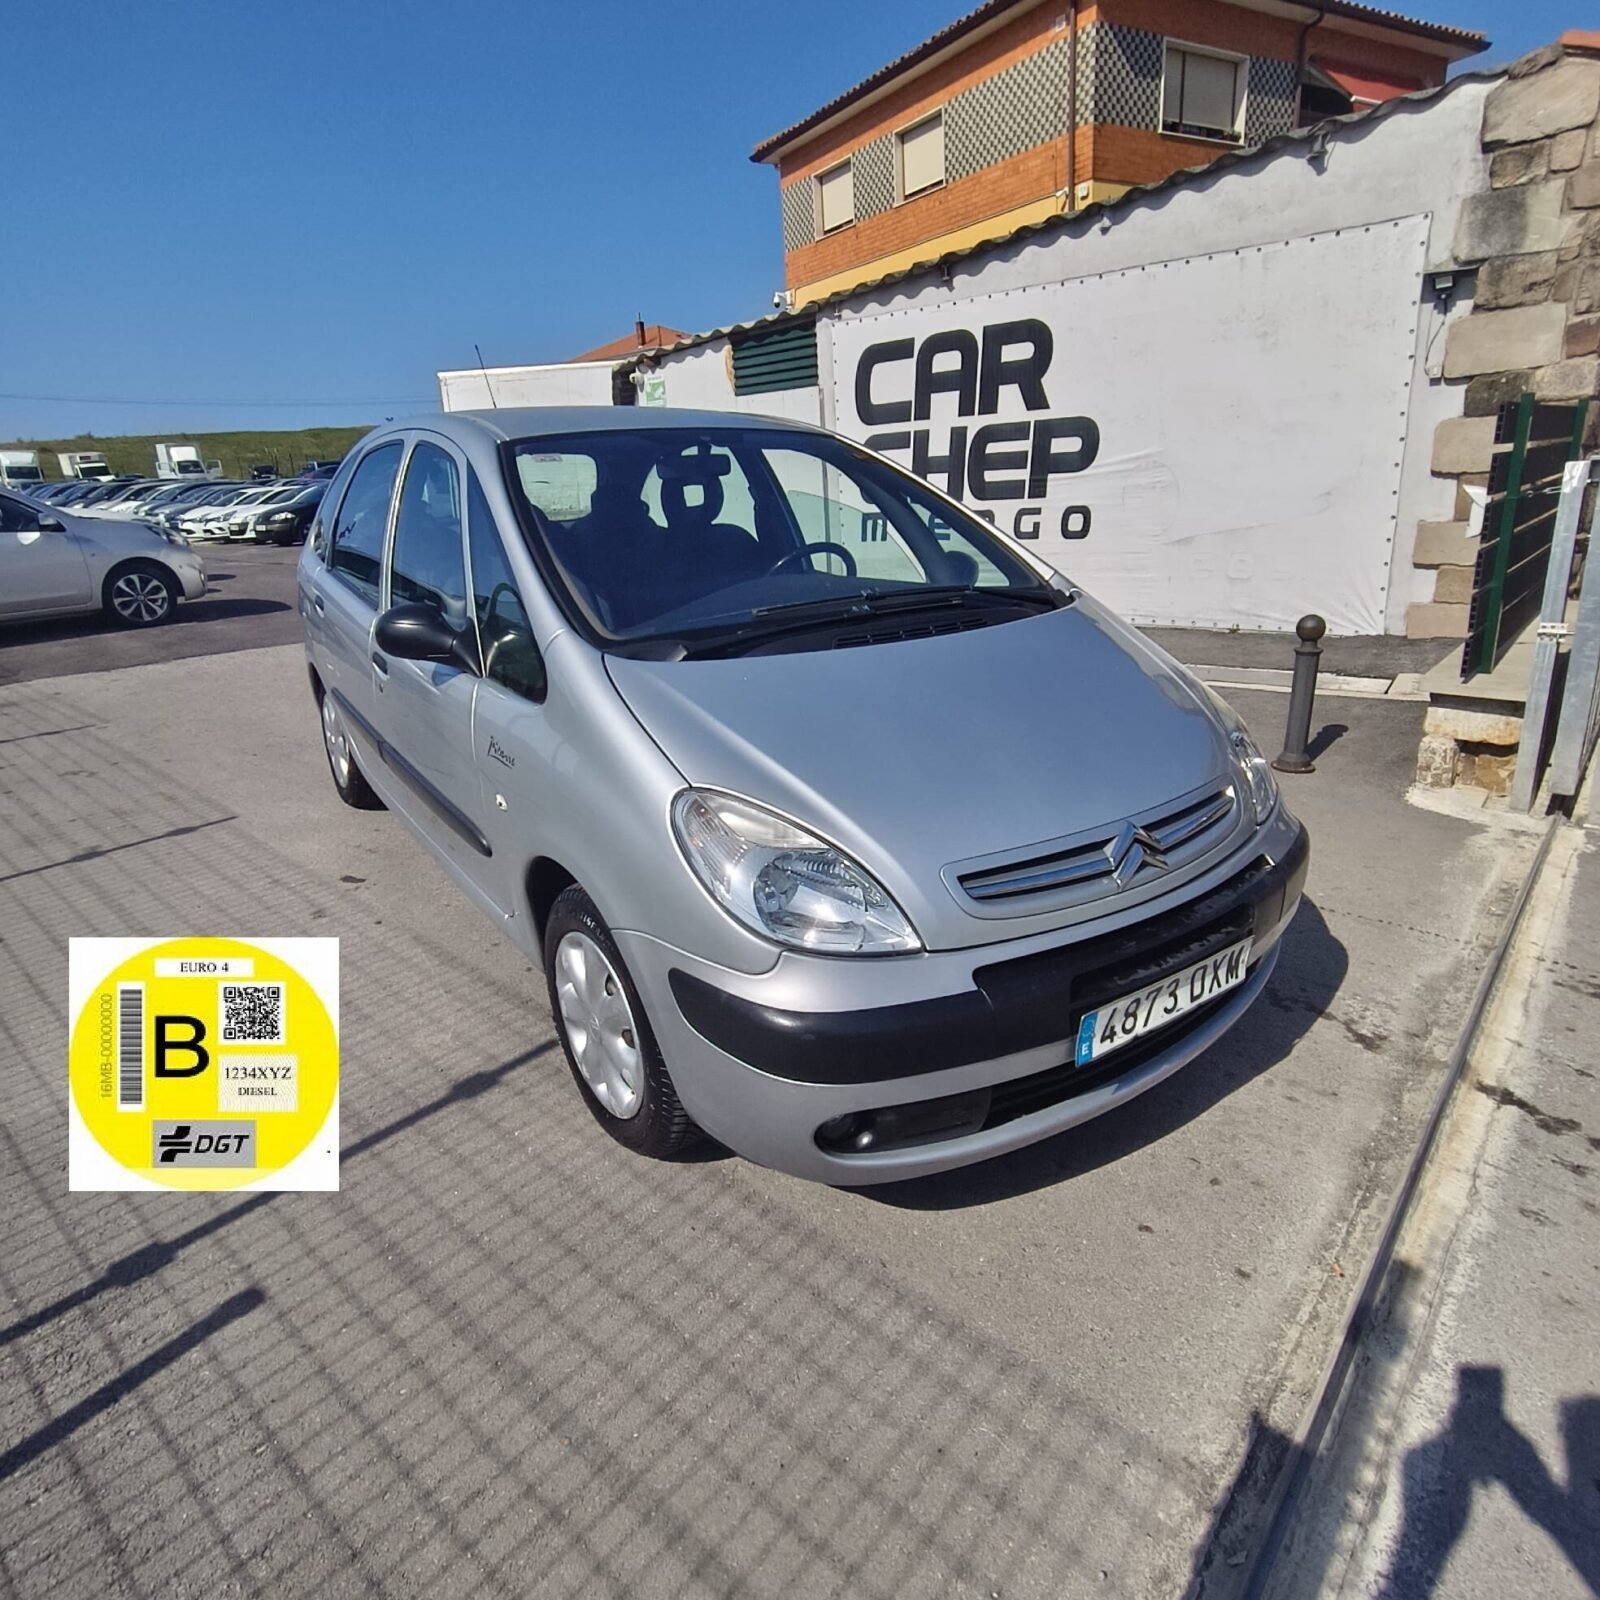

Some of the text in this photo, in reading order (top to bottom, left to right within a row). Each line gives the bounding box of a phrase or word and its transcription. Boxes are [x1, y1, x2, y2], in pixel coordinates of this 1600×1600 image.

[855, 318, 1053, 426] CAR
[1100, 944, 1246, 1044] 4873 DXM
[1081, 1042, 1091, 1055] E
